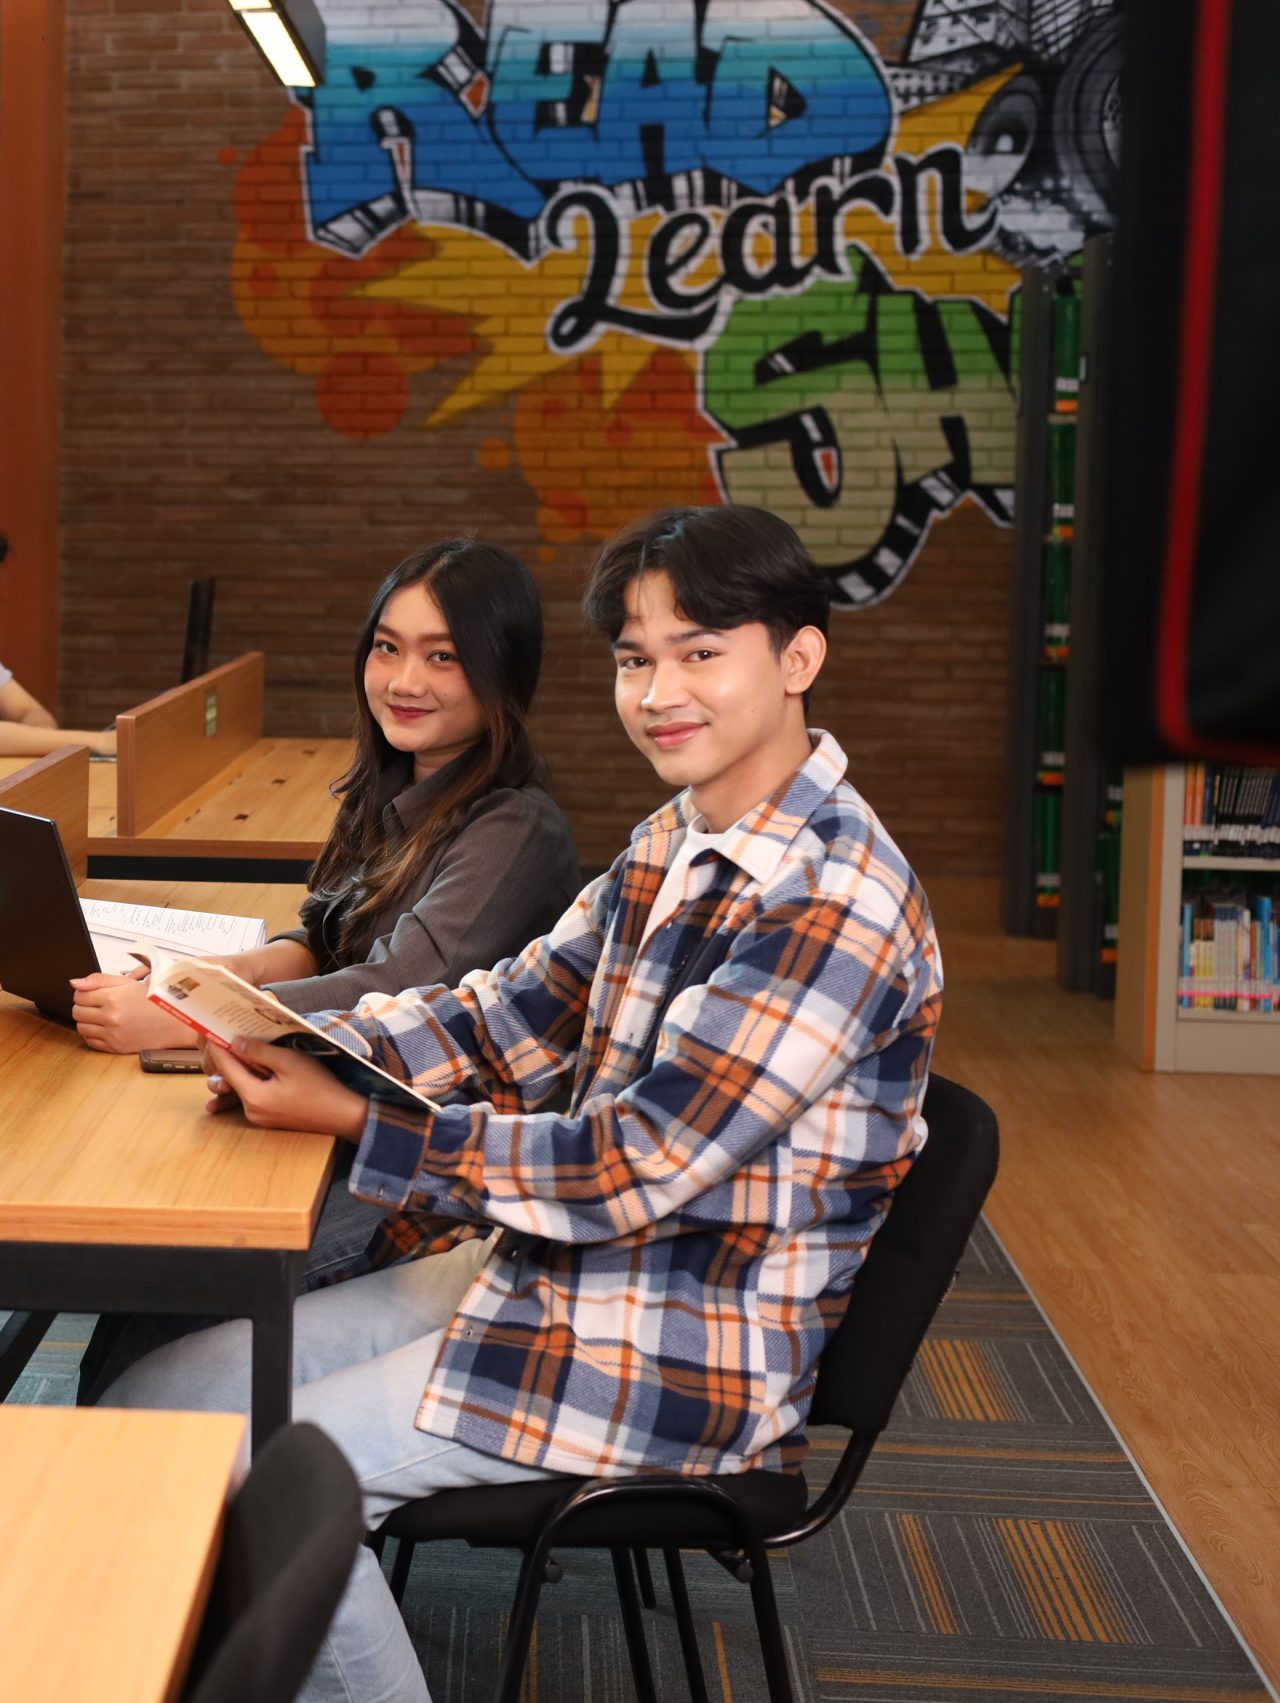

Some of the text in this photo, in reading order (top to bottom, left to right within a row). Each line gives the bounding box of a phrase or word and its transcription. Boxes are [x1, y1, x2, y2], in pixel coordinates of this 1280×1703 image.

[303, 0, 898, 262] READ
[548, 145, 1001, 355] Learn
[697, 240, 1020, 608] SH
